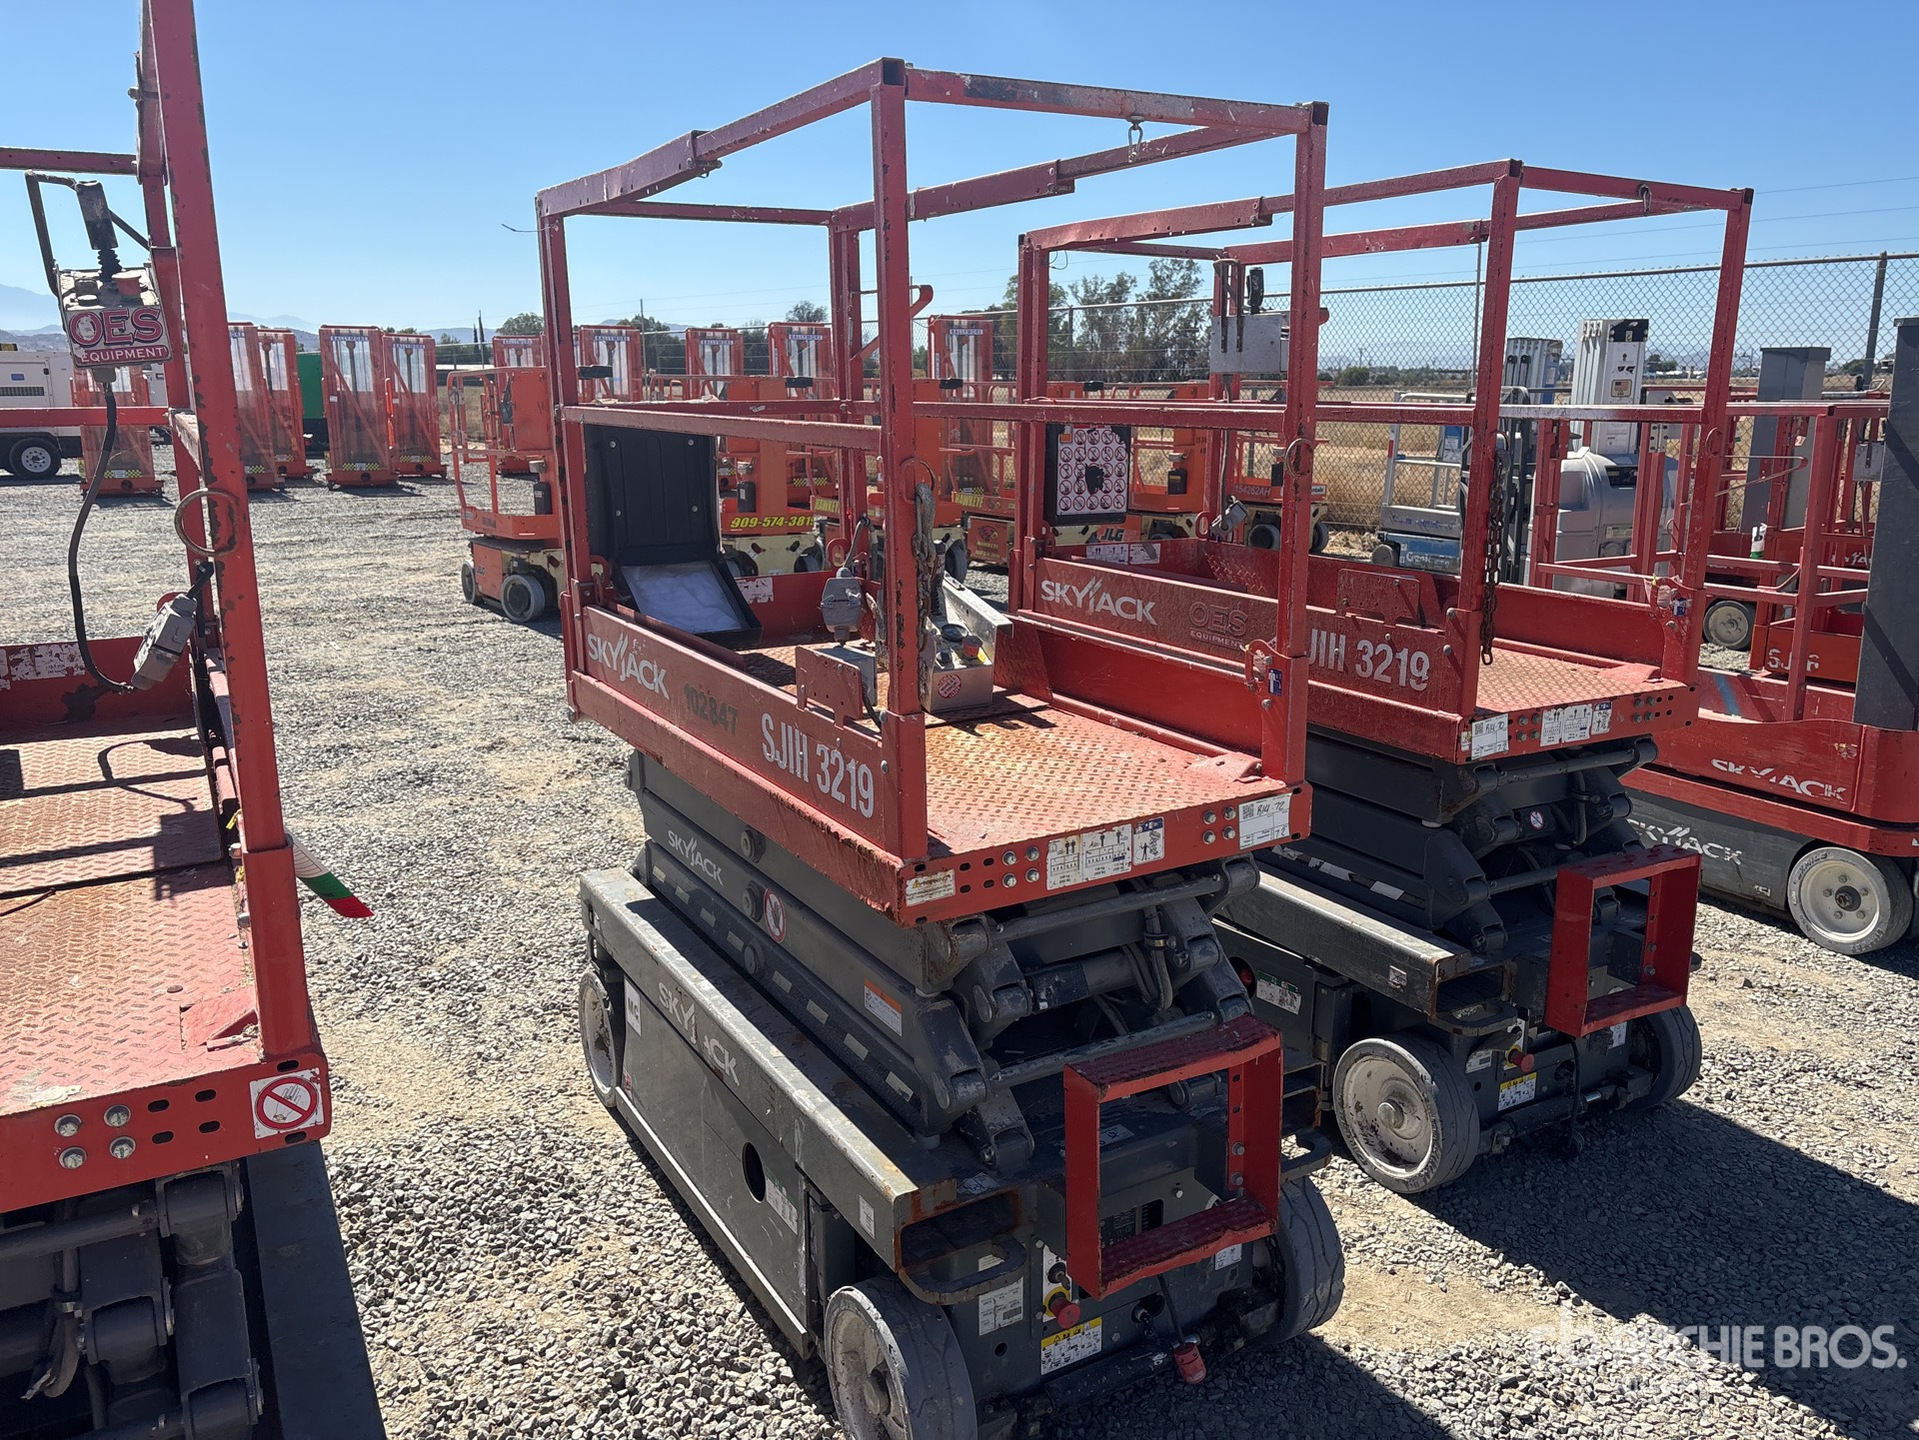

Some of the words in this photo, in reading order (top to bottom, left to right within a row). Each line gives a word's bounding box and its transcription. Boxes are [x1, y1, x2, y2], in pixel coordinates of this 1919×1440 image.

[69, 307, 163, 347] OES
[81, 346, 164, 363] EQUIPMENT
[1101, 528, 1125, 541] JLG
[1041, 576, 1158, 626] SKYJACK
[1189, 601, 1249, 637] OES
[587, 631, 670, 700] SKYJACK
[1308, 628, 1346, 672] JIH
[1355, 639, 1430, 692] 3219
[761, 713, 809, 783] SJIH
[816, 744, 874, 818] 3219
[1711, 758, 1848, 804] SKYACK
[668, 830, 723, 886] SKYJACK
